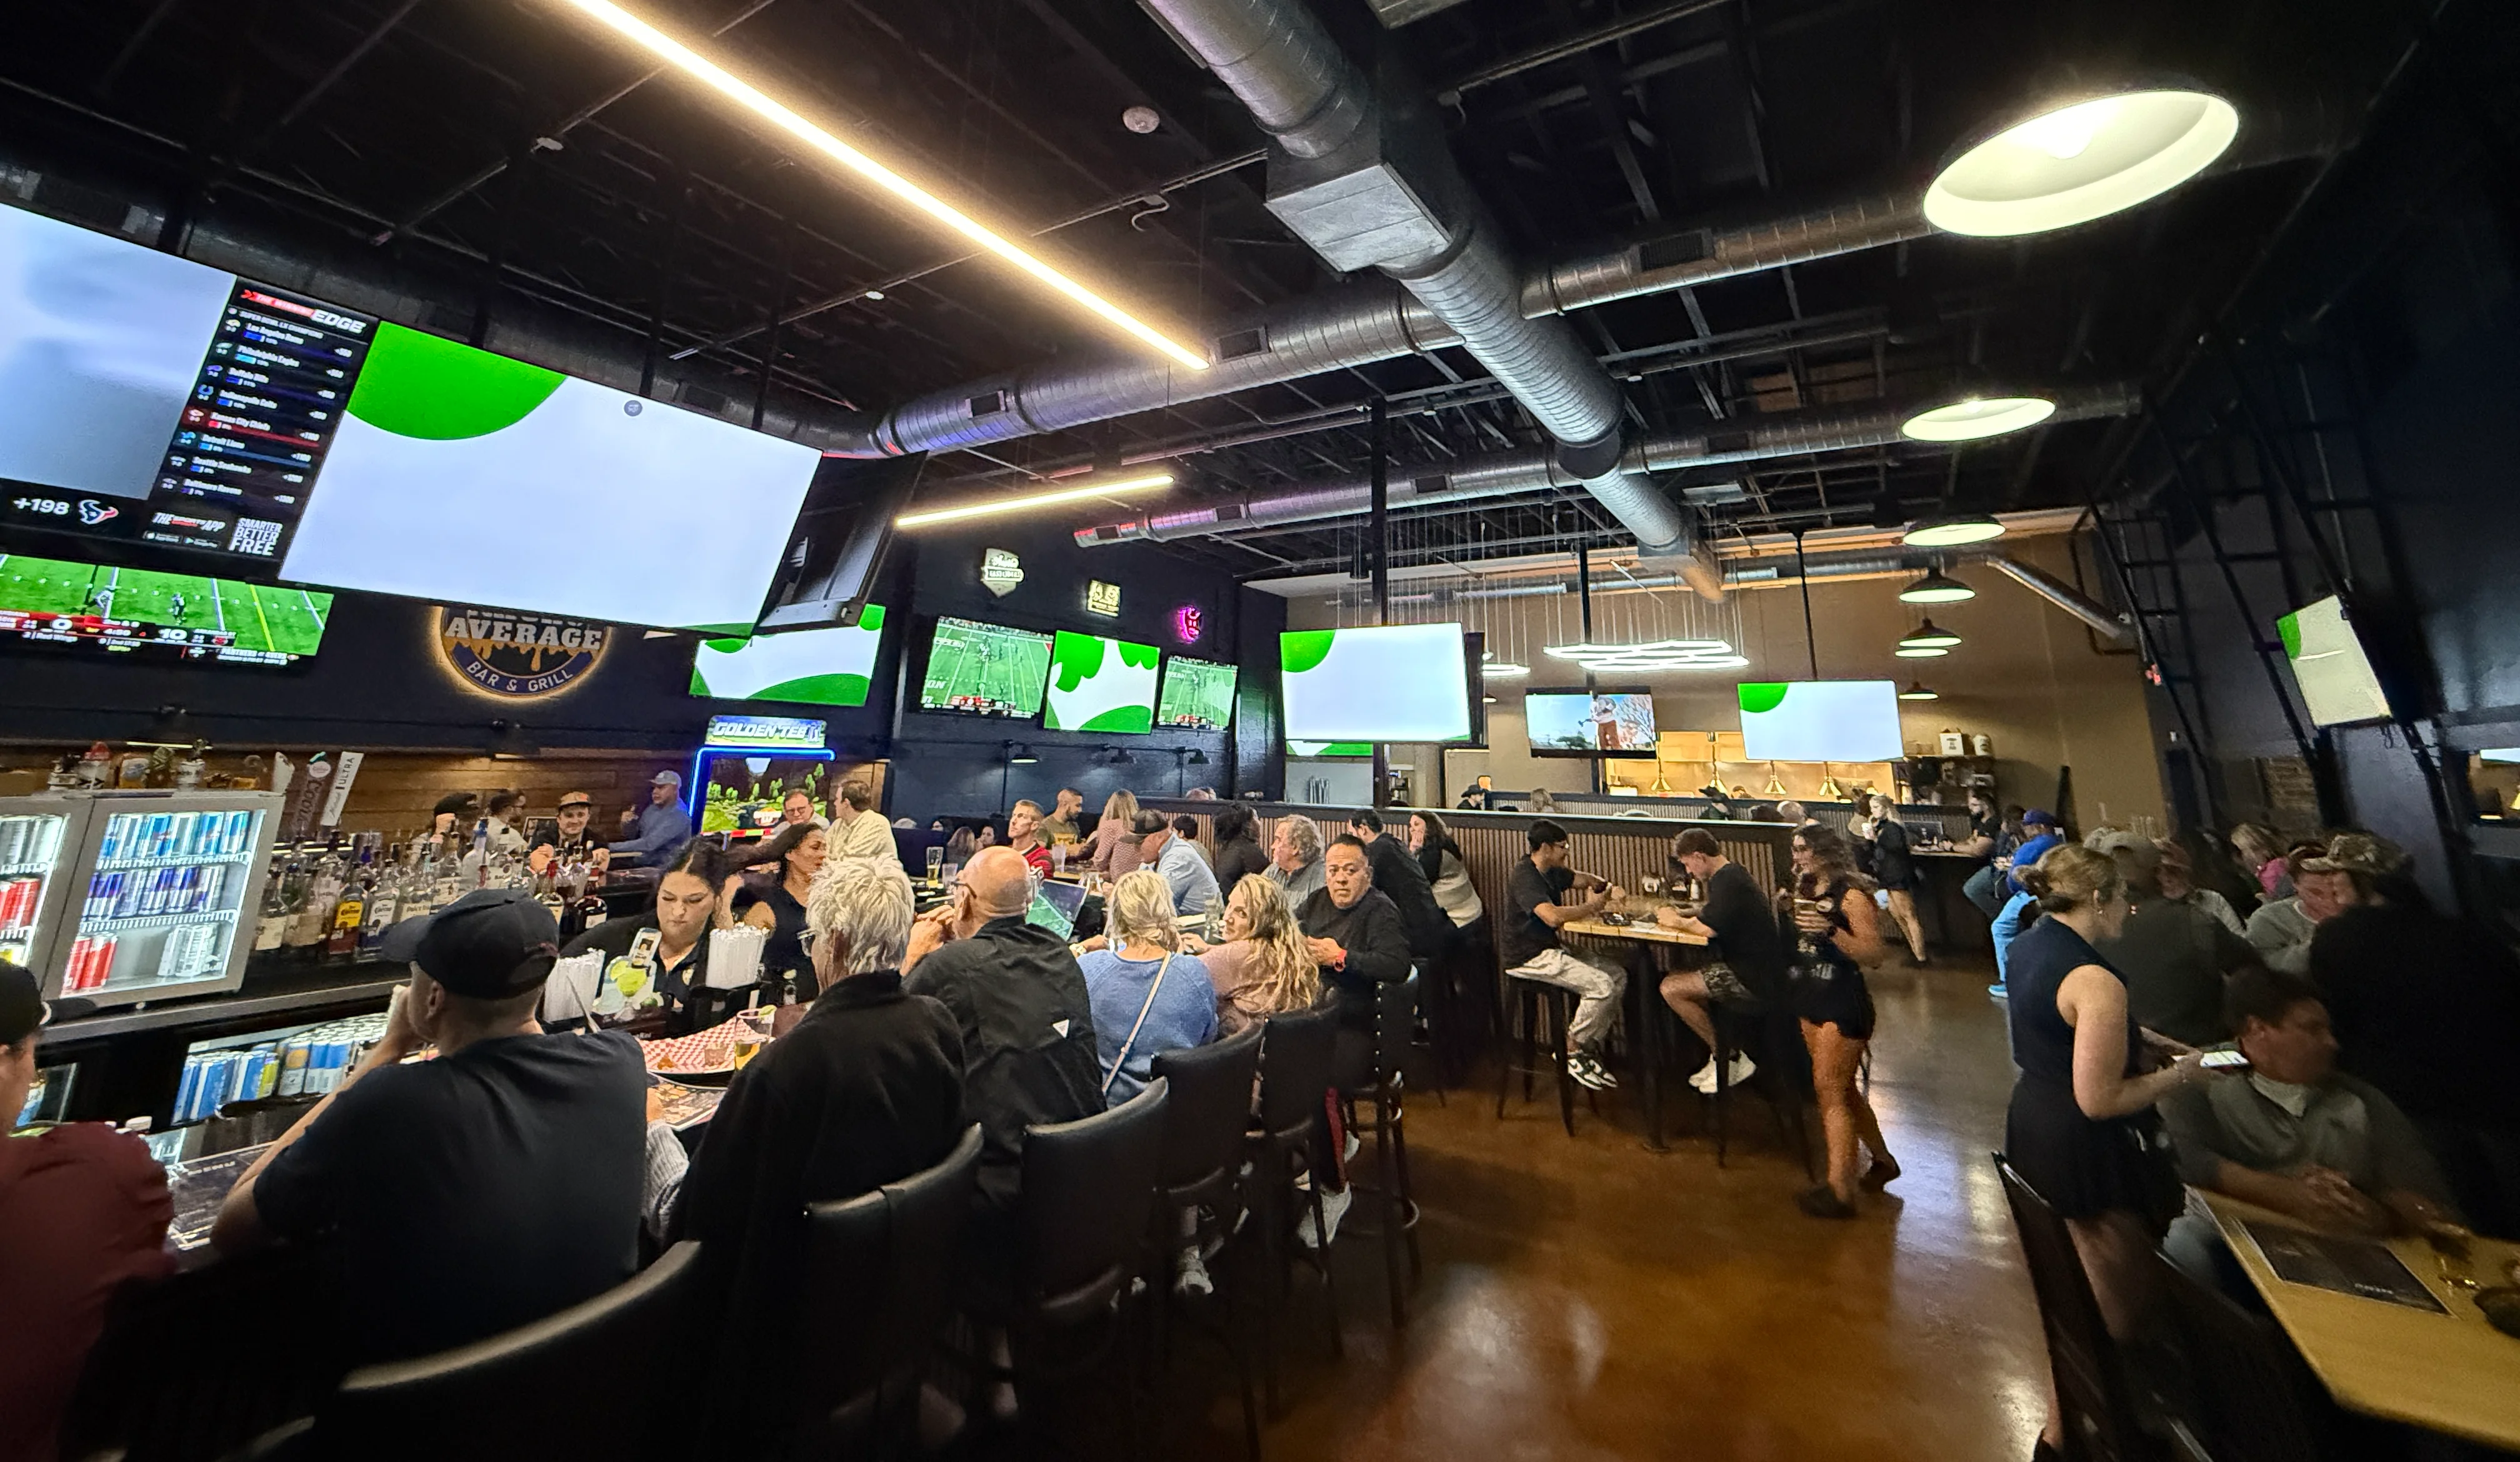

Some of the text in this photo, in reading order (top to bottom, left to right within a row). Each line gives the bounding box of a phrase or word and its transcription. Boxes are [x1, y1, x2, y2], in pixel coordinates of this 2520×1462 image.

[309, 309, 367, 334] EDGE
[14, 498, 69, 515] +198
[152, 512, 174, 525] THE
[201, 521, 226, 532] APP
[238, 517, 283, 533] SMARTER
[234, 526, 279, 543] BETTER
[228, 537, 276, 556] FREE
[50, 618, 73, 631] 0
[444, 617, 602, 650] AVERAGE
[159, 628, 188, 640] 10
[468, 661, 573, 692] BAR & GRILL
[712, 721, 779, 738] GOLDEN
[338, 758, 355, 784] ULTRA
